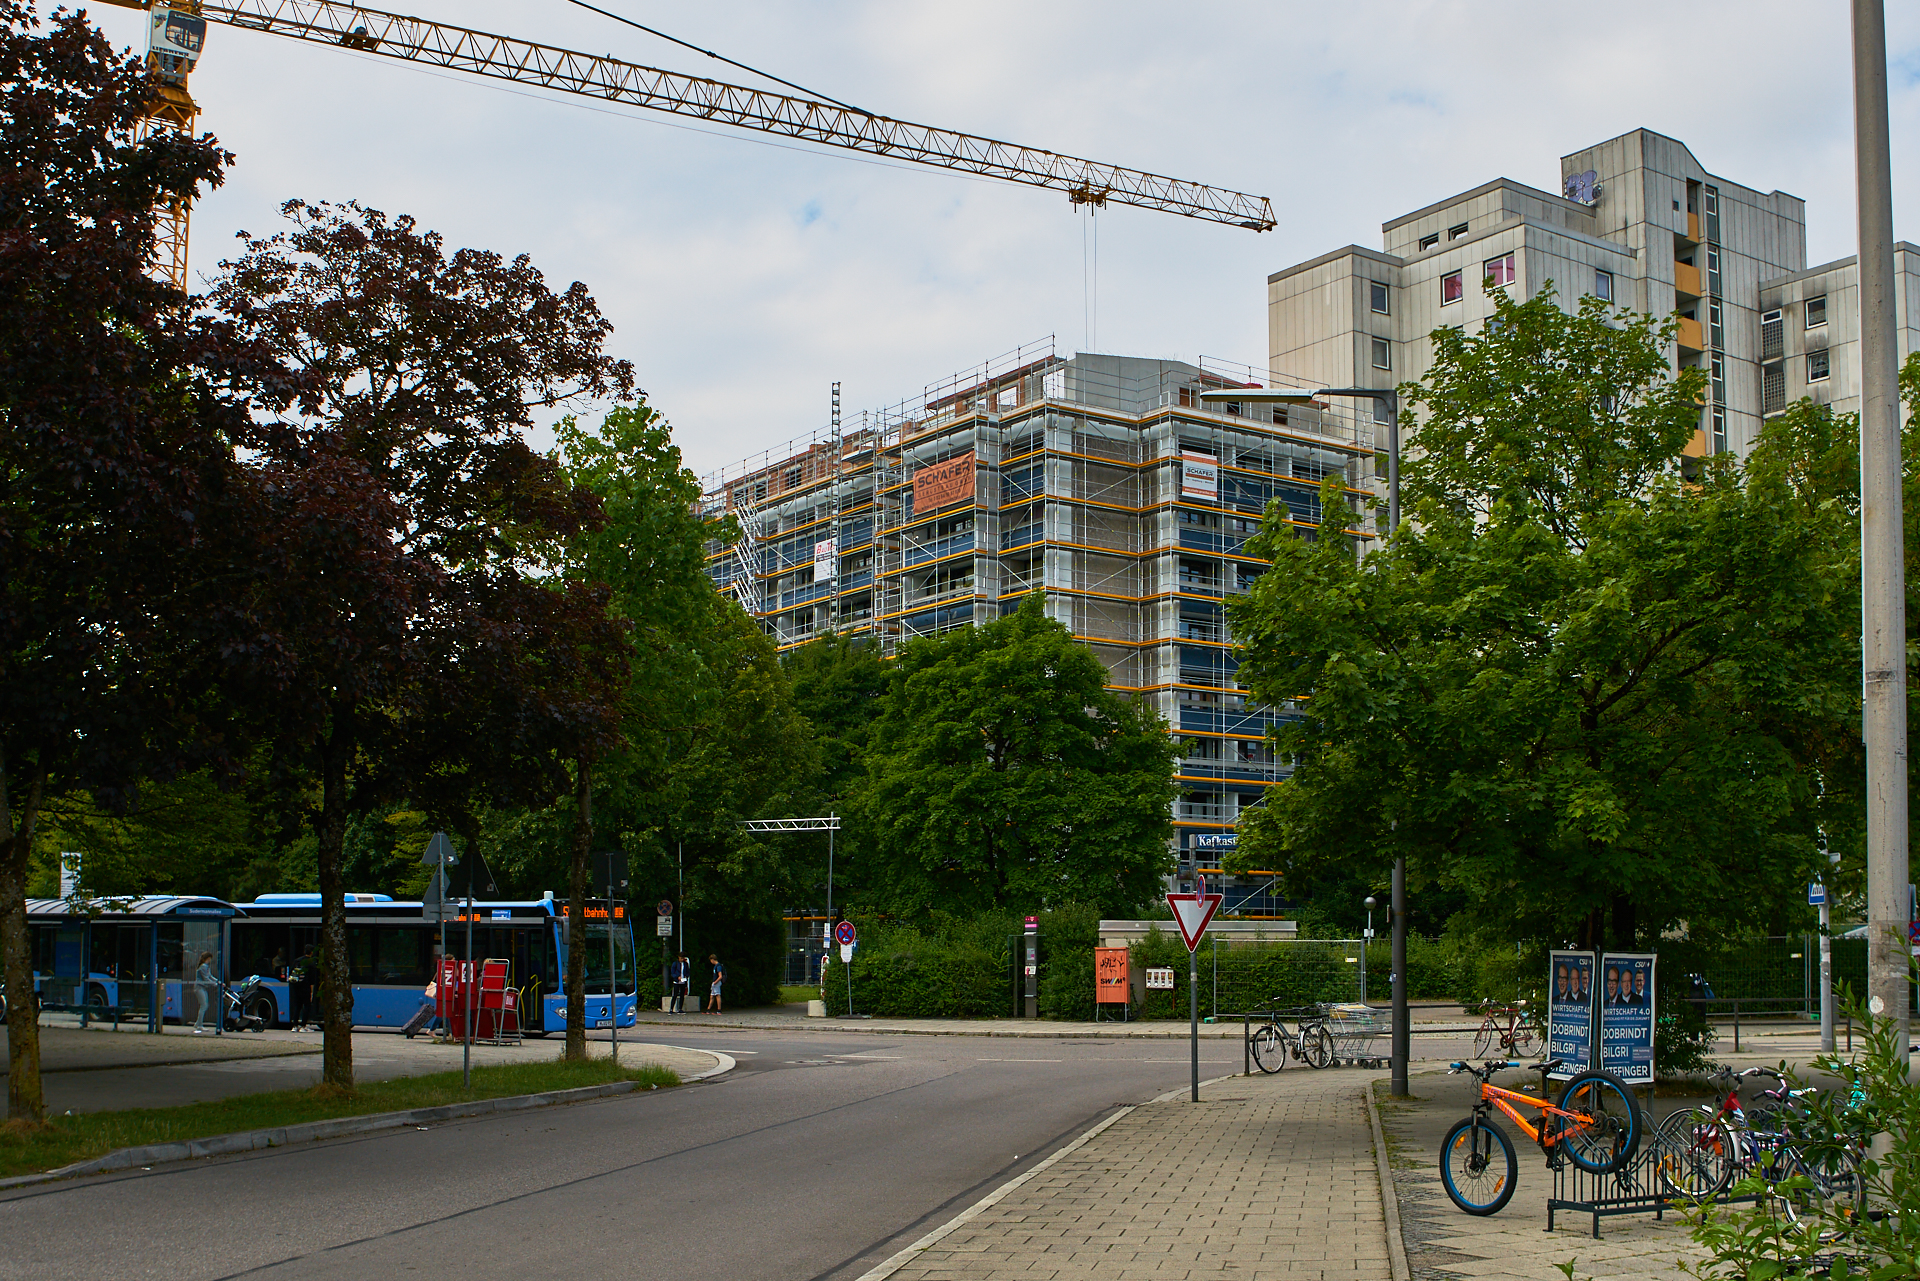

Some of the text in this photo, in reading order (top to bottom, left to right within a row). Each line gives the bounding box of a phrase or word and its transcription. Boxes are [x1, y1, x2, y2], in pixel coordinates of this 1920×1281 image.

[1552, 1004, 1584, 1012] WIRTSCHAFT
[1552, 1024, 1588, 1037] DOBRINDT
[1604, 1028, 1647, 1039] DOBRINDT
[1551, 1042, 1576, 1054] BILGRI
[1604, 1046, 1628, 1058] BILGRI
